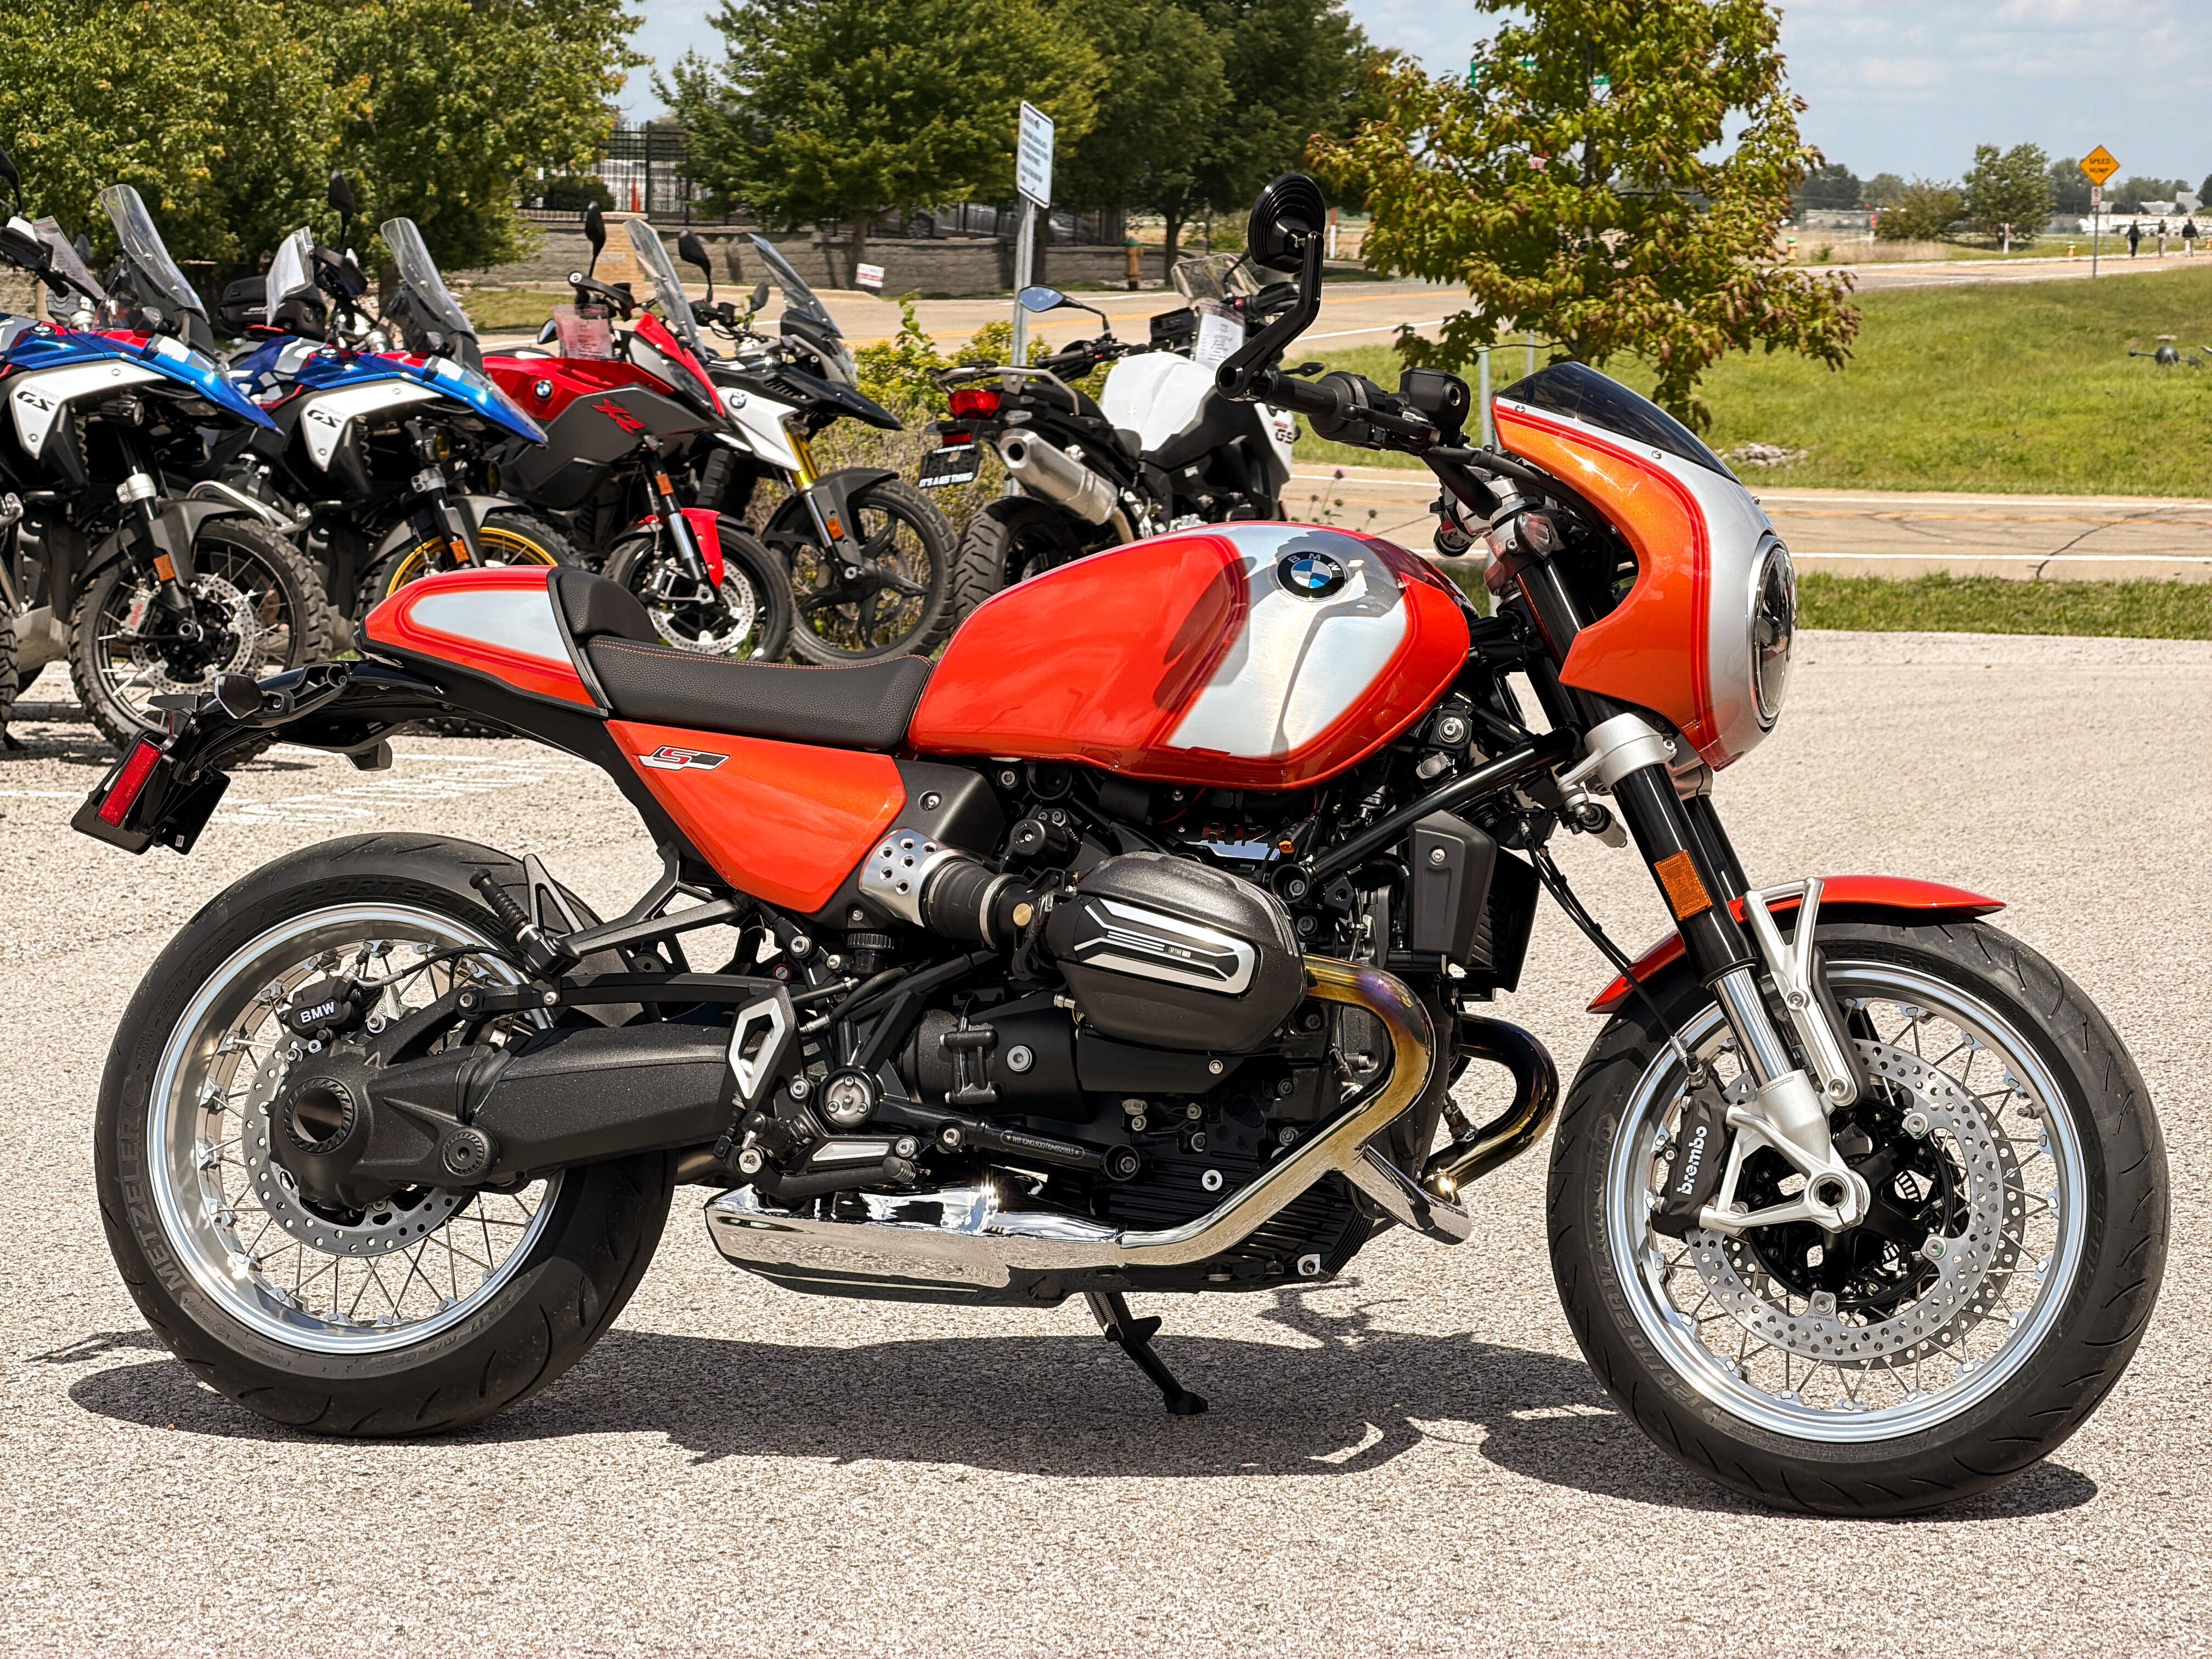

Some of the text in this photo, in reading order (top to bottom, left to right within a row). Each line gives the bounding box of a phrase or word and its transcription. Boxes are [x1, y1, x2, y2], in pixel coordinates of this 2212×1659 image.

[17, 391, 55, 411] GS
[591, 398, 646, 435] XR
[307, 409, 342, 428] GS
[1276, 428, 1293, 444] GS
[1287, 552, 1341, 571] BMW
[278, 878, 452, 912] SPORTEC
[300, 1001, 335, 1024] BMW
[1676, 1126, 1707, 1195] brembo
[120, 1121, 187, 1291] METZELER
[1607, 1293, 1634, 1329] ZR
[1629, 1334, 1701, 1407] 120/70
